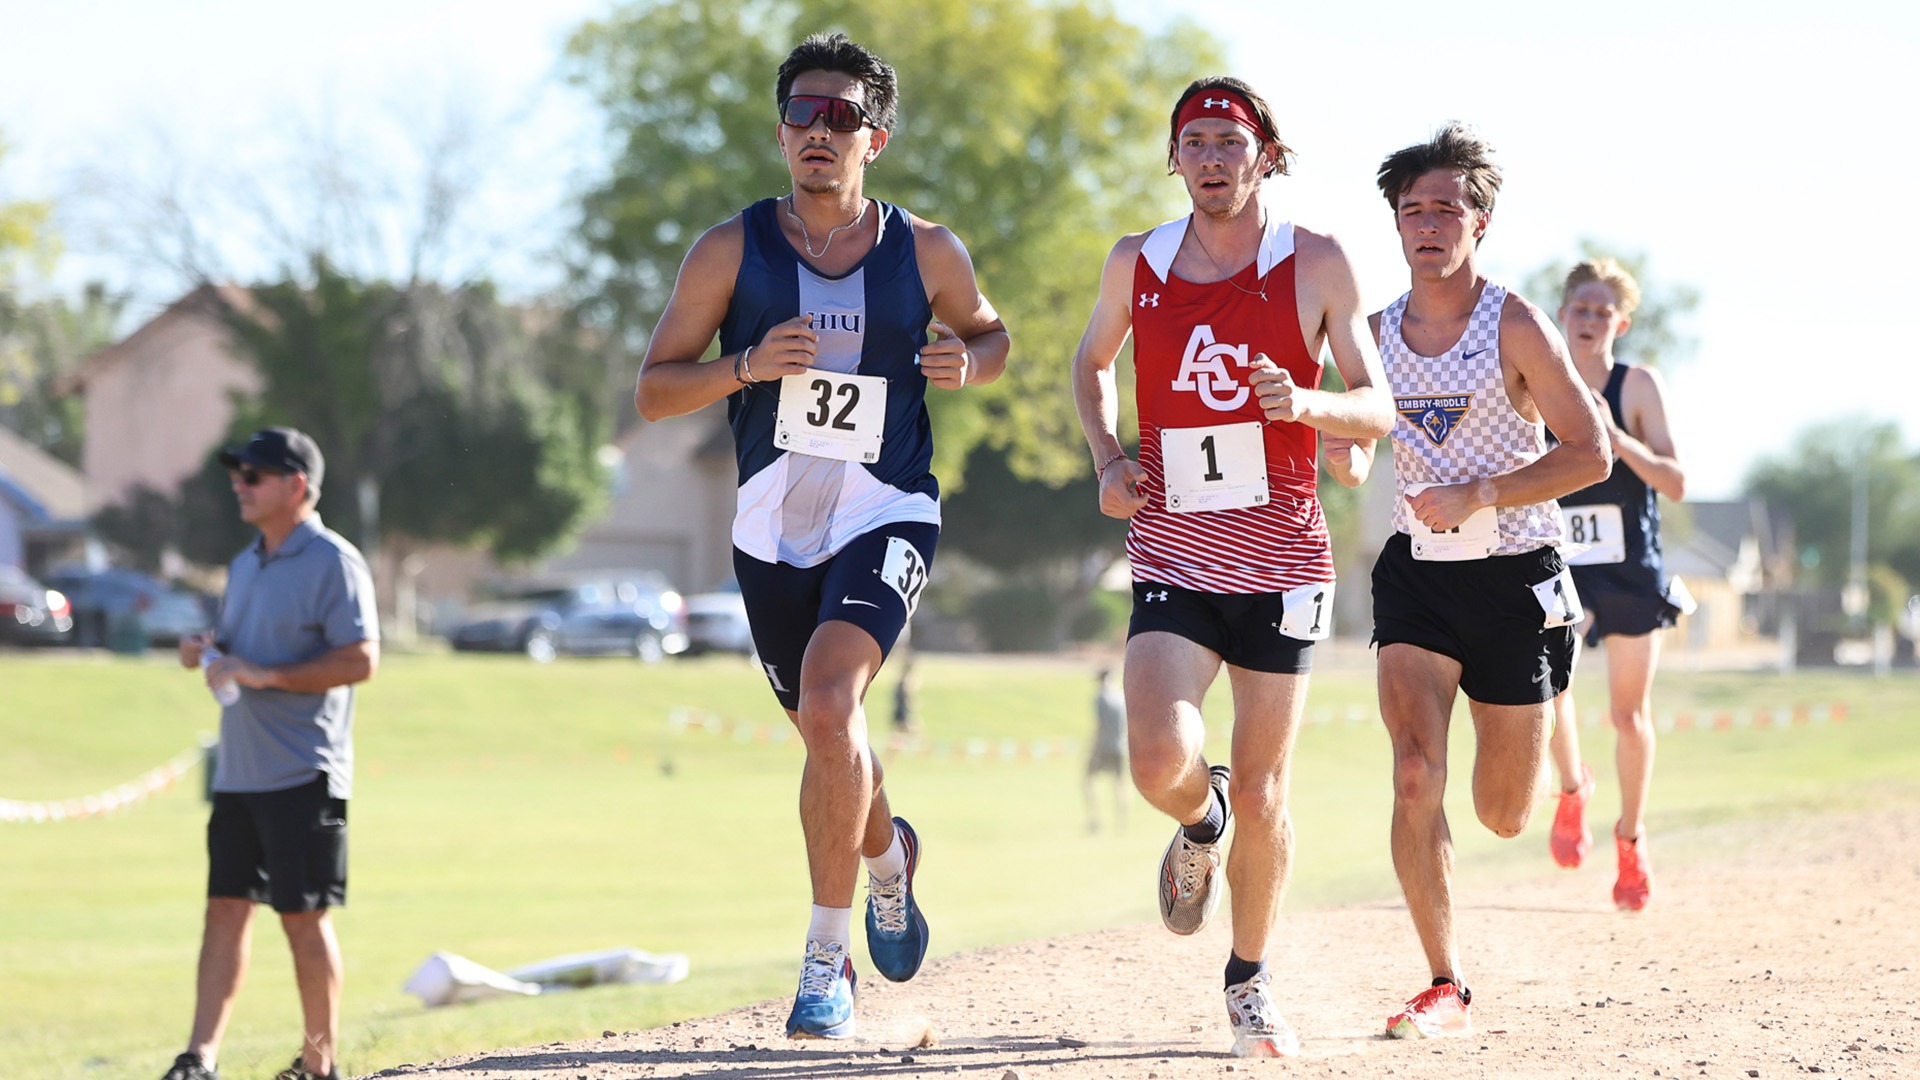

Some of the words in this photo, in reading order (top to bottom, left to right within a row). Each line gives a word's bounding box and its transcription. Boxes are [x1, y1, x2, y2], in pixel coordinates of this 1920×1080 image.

[806, 311, 862, 335] HIU
[1171, 324, 1250, 411] AC
[806, 379, 861, 431] 32
[1398, 397, 1467, 410] EMBRY-RIDDLE
[1201, 435, 1223, 481] 1
[1571, 514, 1601, 543] 81
[898, 549, 924, 612] 32
[1309, 591, 1324, 634] 1
